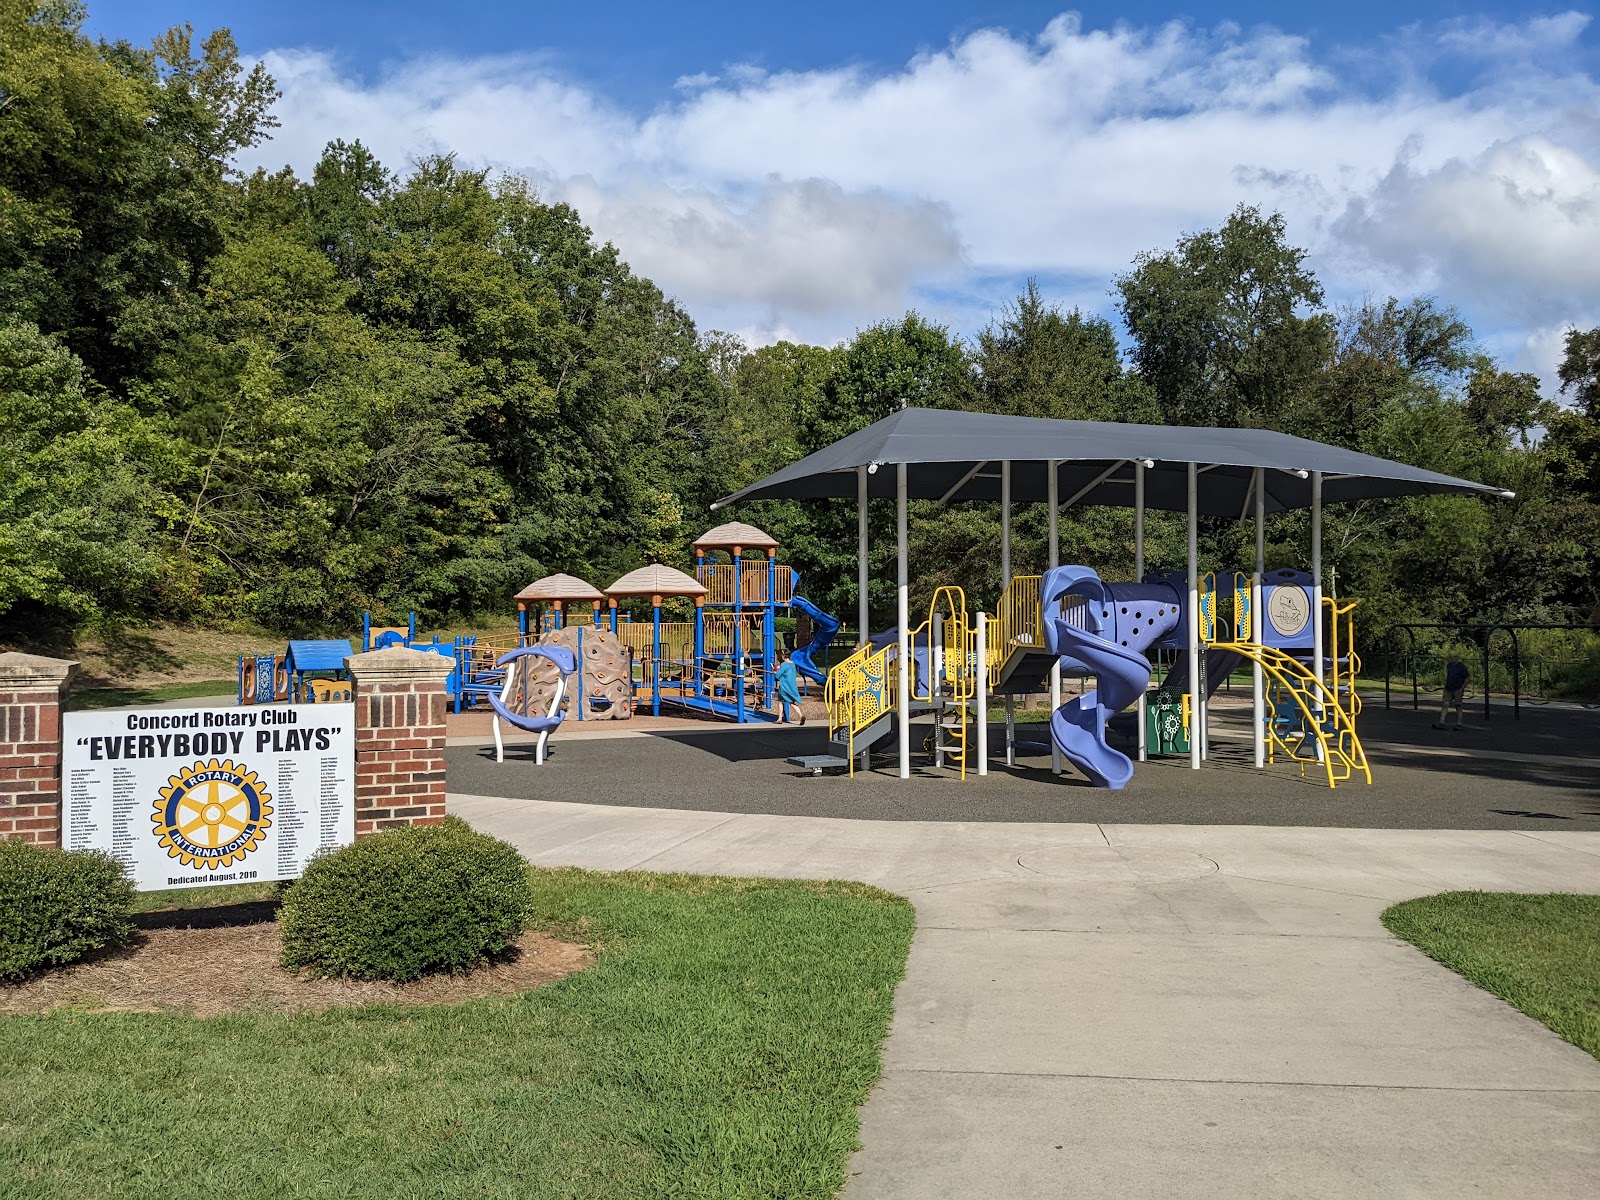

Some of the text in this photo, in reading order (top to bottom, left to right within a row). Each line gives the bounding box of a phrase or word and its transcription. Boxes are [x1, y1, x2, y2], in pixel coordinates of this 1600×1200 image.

[127, 709, 297, 731] Concord Rotary Club
[77, 727, 342, 762] “EVERYBODY PLAYS”
[188, 772, 239, 787] ROTARY
[172, 828, 256, 857] INTERNATIONAL
[167, 870, 258, 885] Dedicated August, 2010
